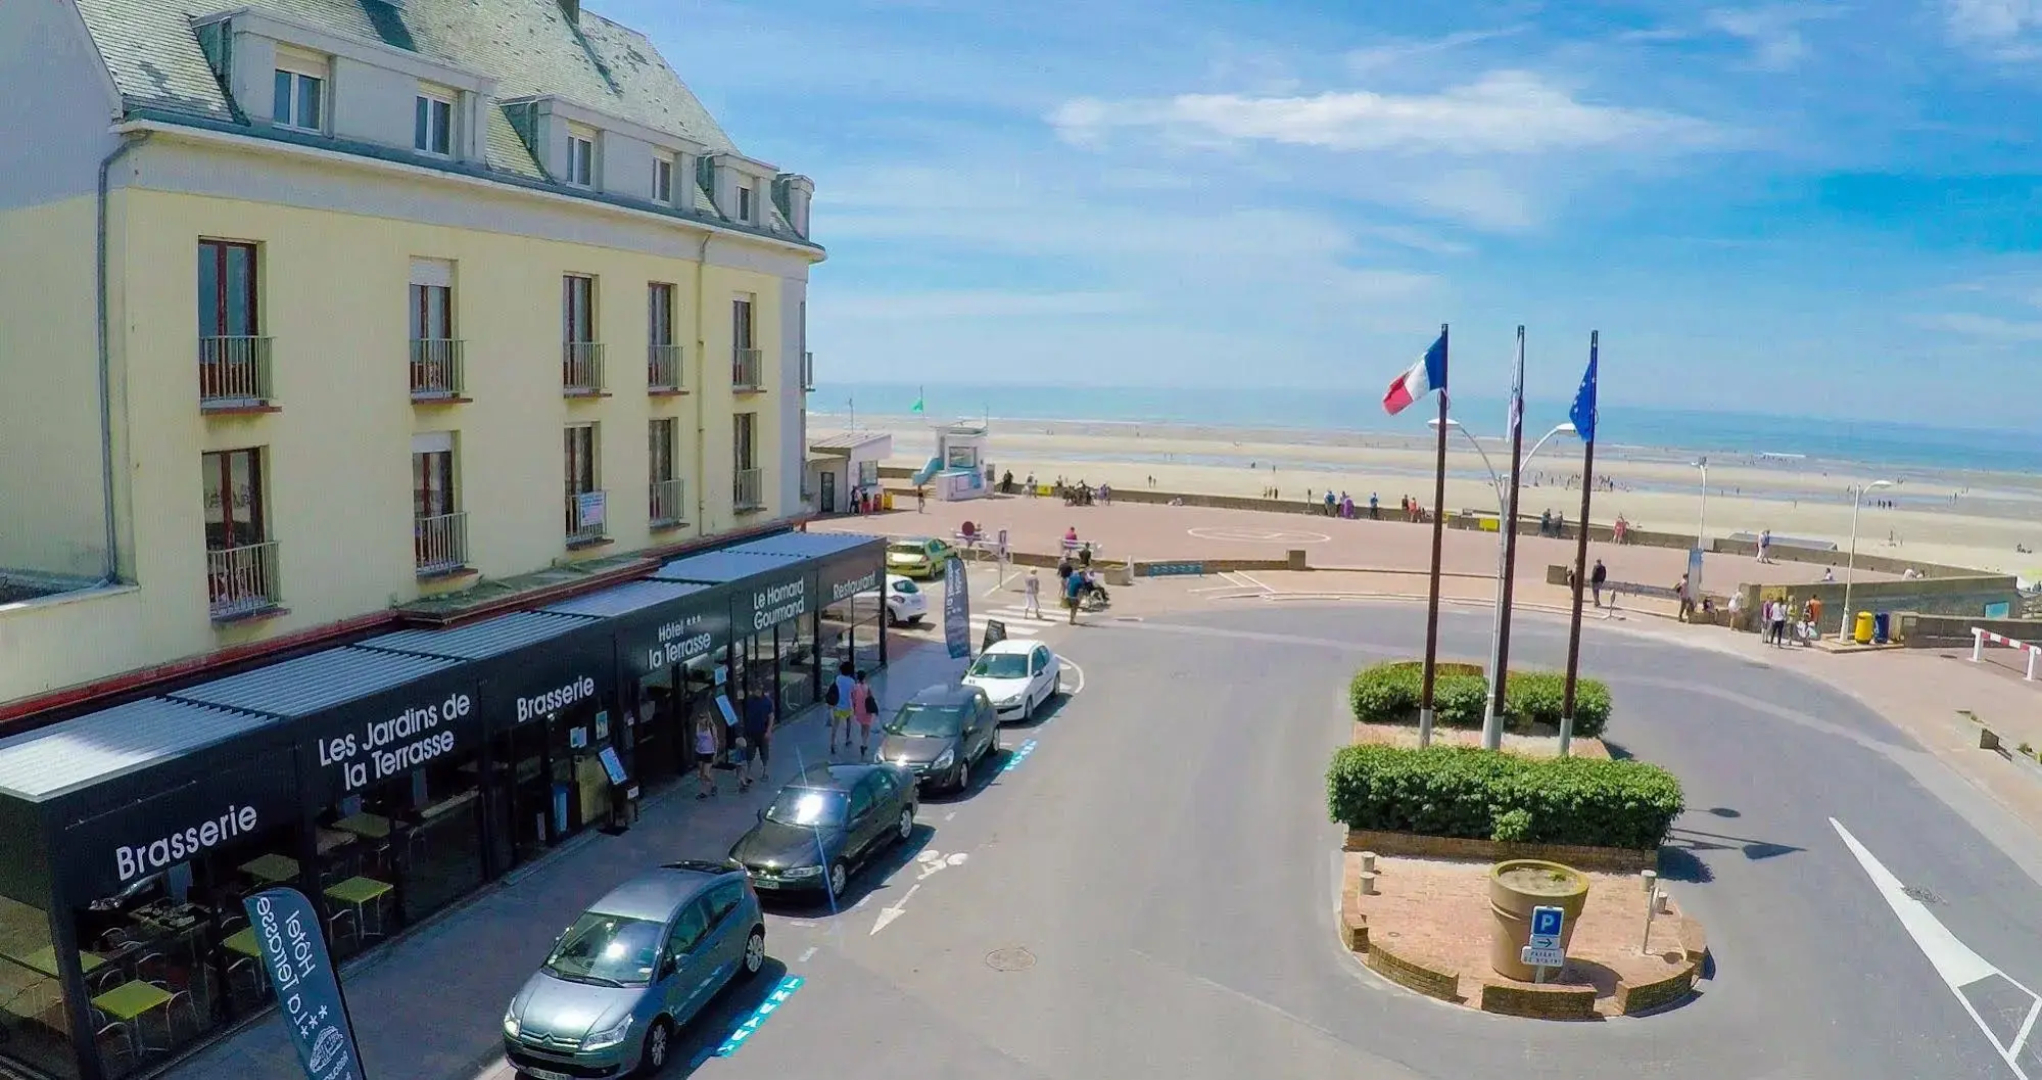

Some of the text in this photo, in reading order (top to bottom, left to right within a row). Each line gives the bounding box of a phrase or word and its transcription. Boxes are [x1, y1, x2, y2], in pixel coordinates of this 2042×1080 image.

[753, 576, 804, 610] Le Homard
[833, 571, 876, 600] Restaurant
[658, 620, 685, 642] Hôtel
[754, 596, 805, 630] Gourmand
[648, 632, 711, 670] la Terrasse
[516, 675, 595, 723] Brasserie
[318, 693, 471, 767] Les Jardins de
[343, 730, 455, 791] la Terrasse
[116, 805, 257, 881] Brasserie
[1540, 913, 1555, 931] P
